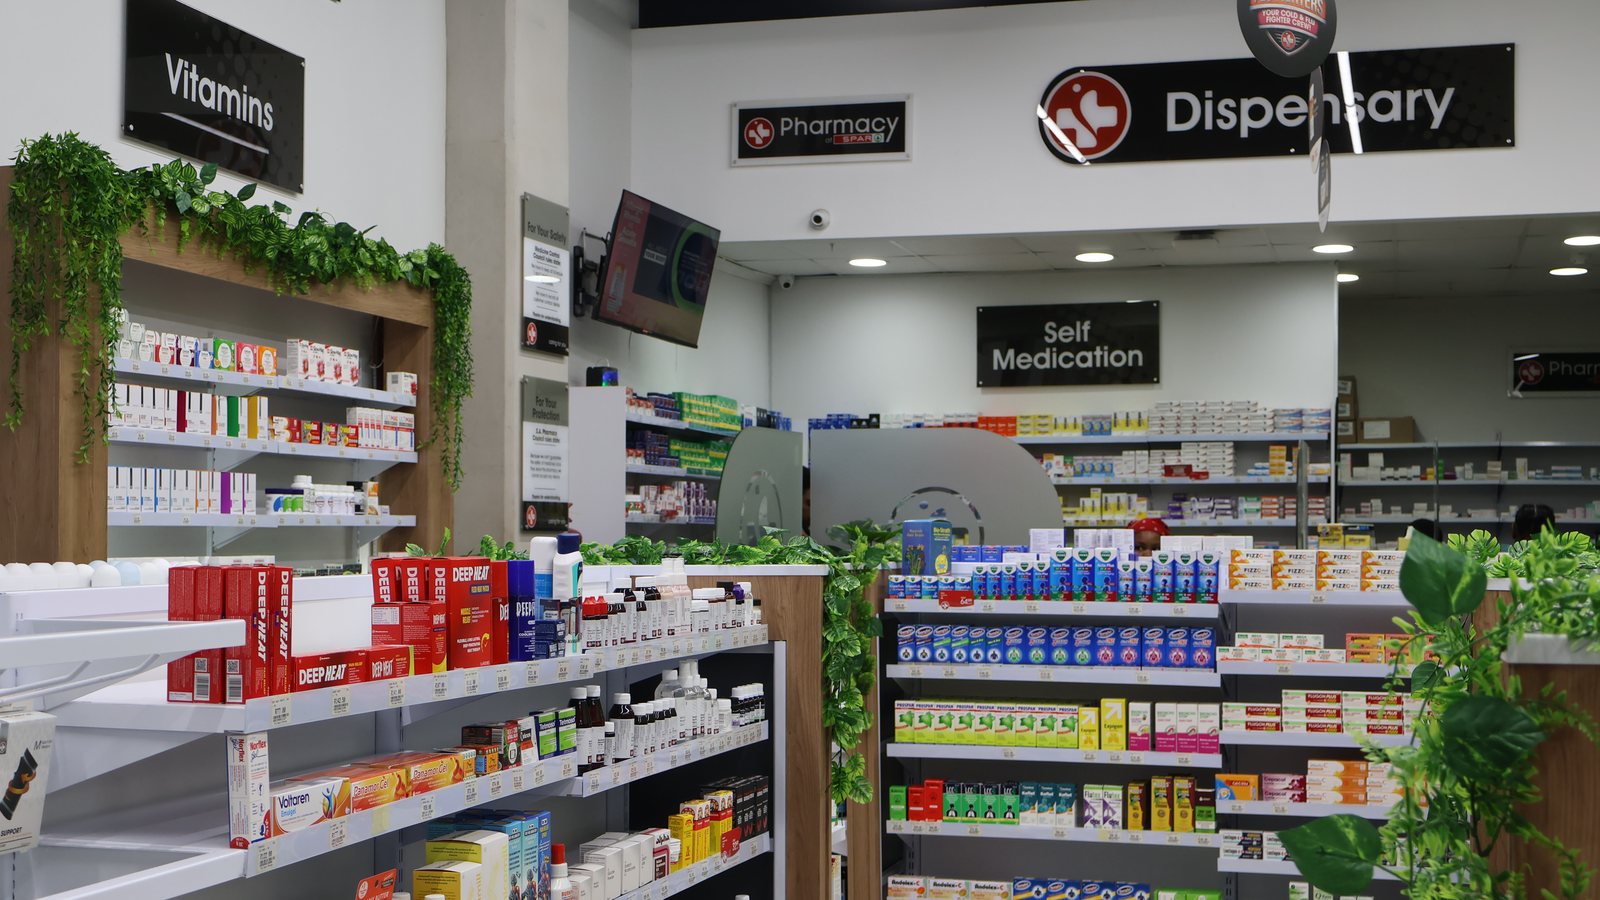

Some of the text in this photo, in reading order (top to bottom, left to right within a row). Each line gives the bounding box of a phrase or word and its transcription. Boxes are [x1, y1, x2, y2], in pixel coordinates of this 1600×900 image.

[1266, 16, 1291, 24] FIGHTER
[1281, 10, 1298, 18] COLD
[164, 52, 275, 132] Vitamins
[780, 116, 899, 142] Pharmacy
[527, 221, 566, 245] For Your Safety
[1044, 320, 1091, 343] Self
[992, 346, 1143, 370] Medication
[536, 396, 557, 409] For Your
[532, 408, 560, 420] Protection
[406, 567, 419, 601] DEEP
[453, 566, 490, 582] DEEP HEAT
[377, 567, 390, 603] DEEP
[434, 567, 446, 603] DEEP
[256, 571, 267, 662] DEEP HEAT
[279, 571, 289, 660] DEEP HEAT
[299, 664, 347, 685] DEEP HEAT
[250, 740, 267, 751] Norflex
[278, 792, 310, 810] Voltaren
[281, 809, 296, 818] Emulgel
[1, 827, 22, 837] SUPPORT
[655, 833, 670, 845] alpha
